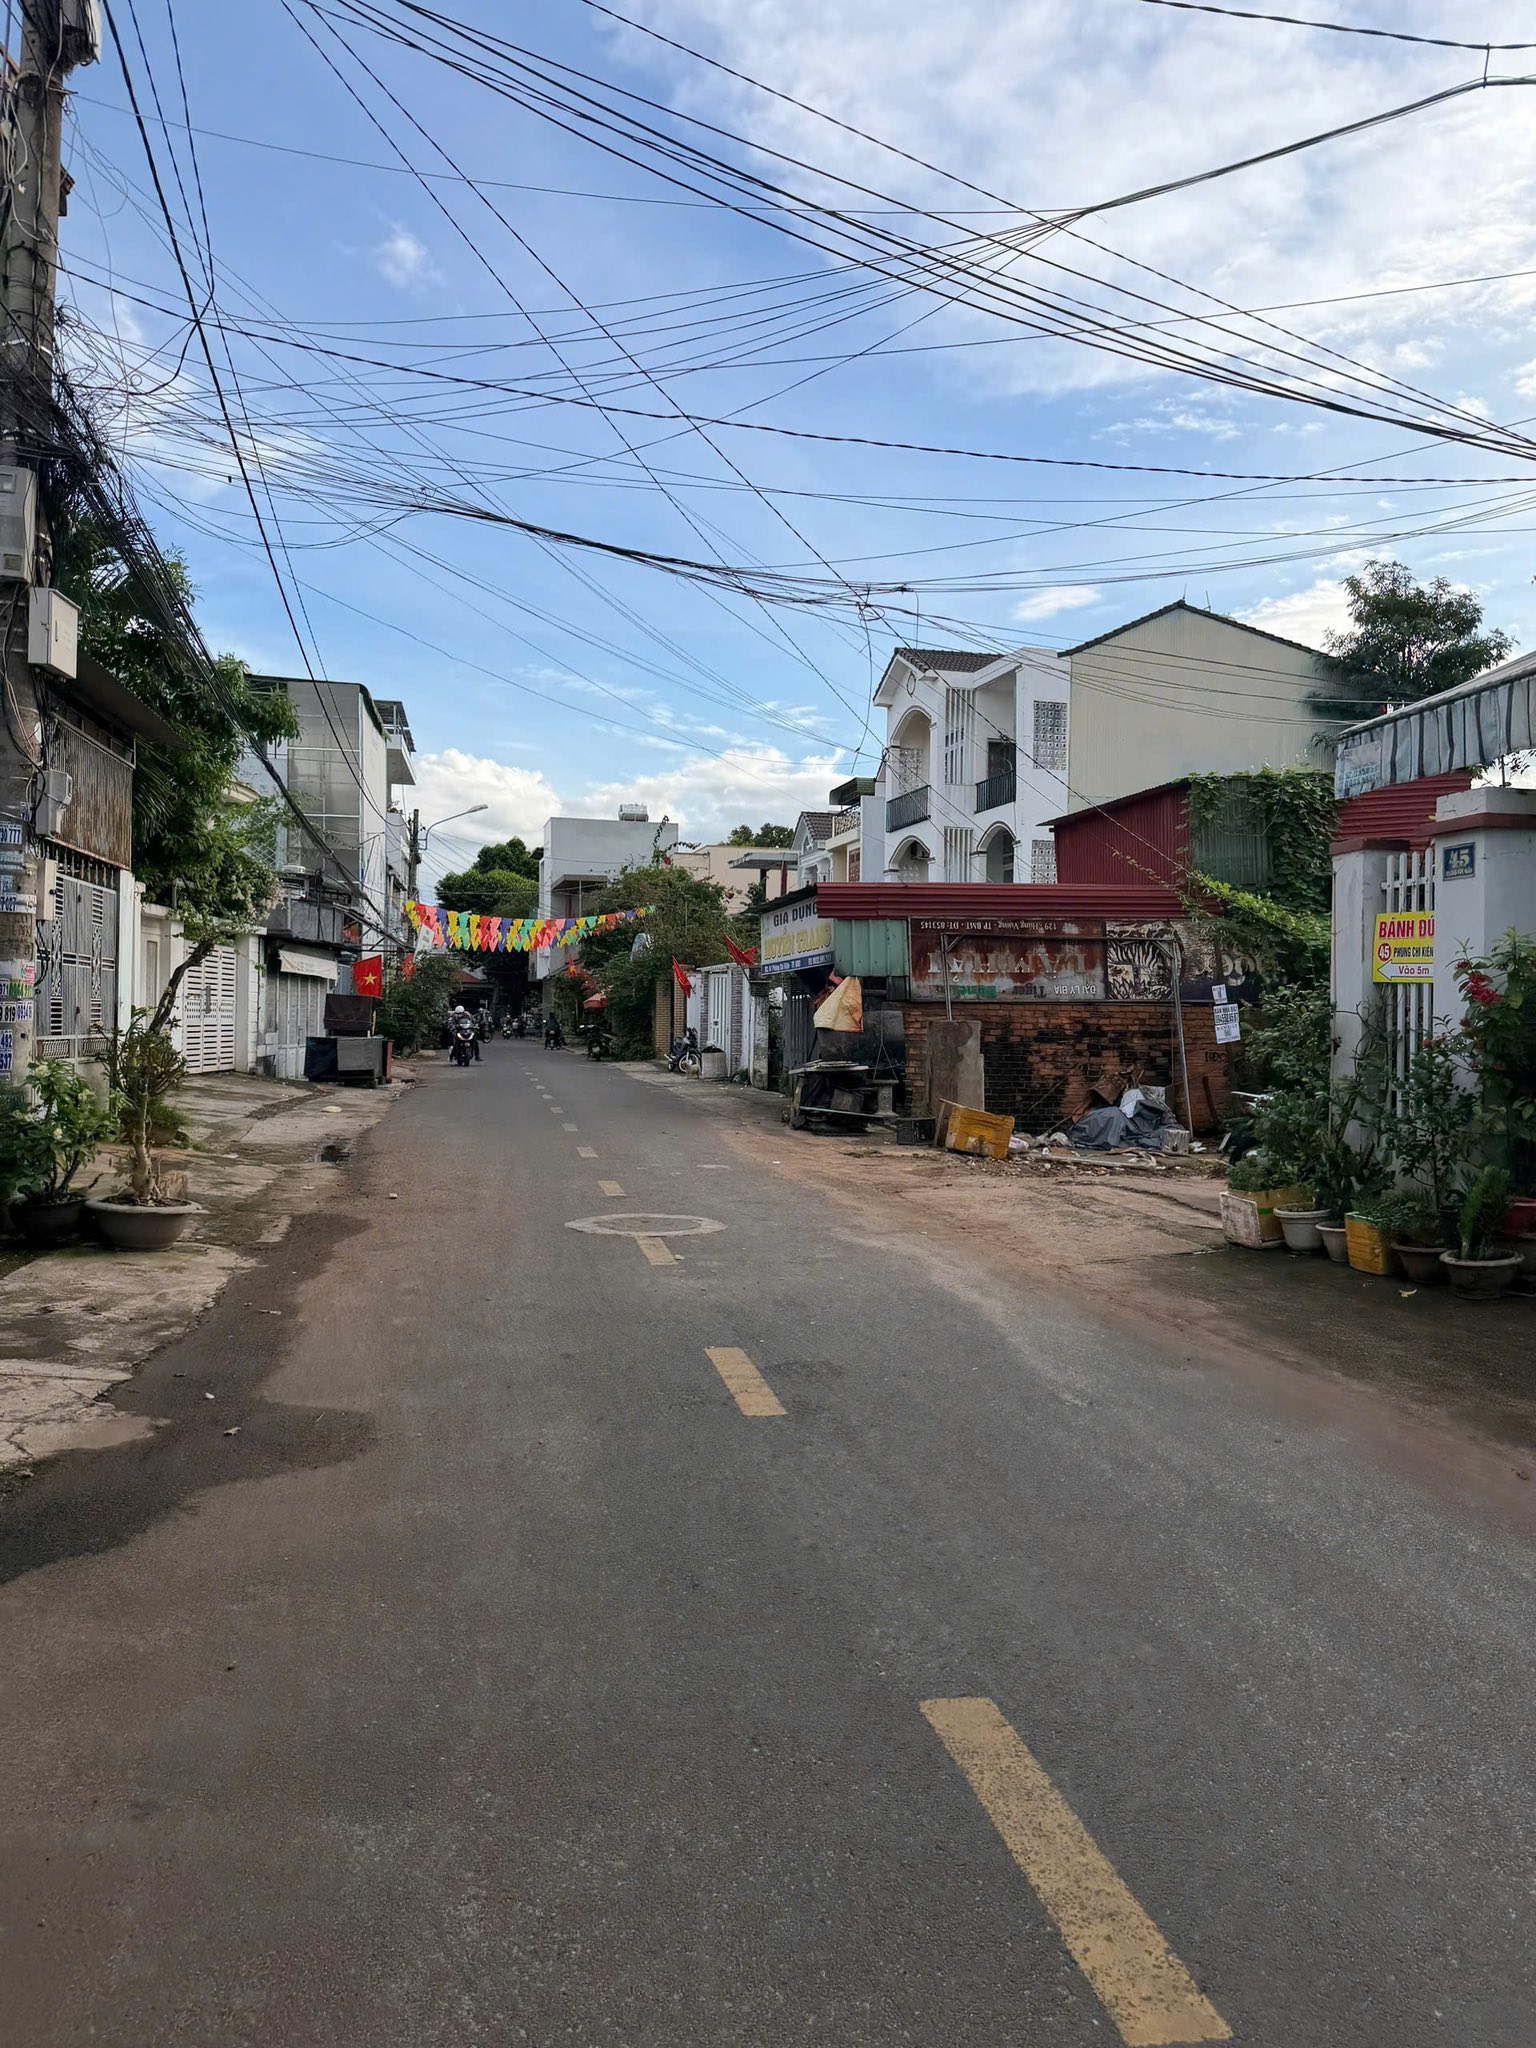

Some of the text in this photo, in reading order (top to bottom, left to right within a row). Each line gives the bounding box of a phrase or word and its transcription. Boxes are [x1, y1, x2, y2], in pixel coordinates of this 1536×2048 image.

[1449, 849, 1470, 868] 45
[773, 911, 789, 927] GIA
[1379, 917, 1415, 938] BÁNH
[1379, 946, 1390, 960] 45
[1399, 964, 1430, 975] Vào 5m
